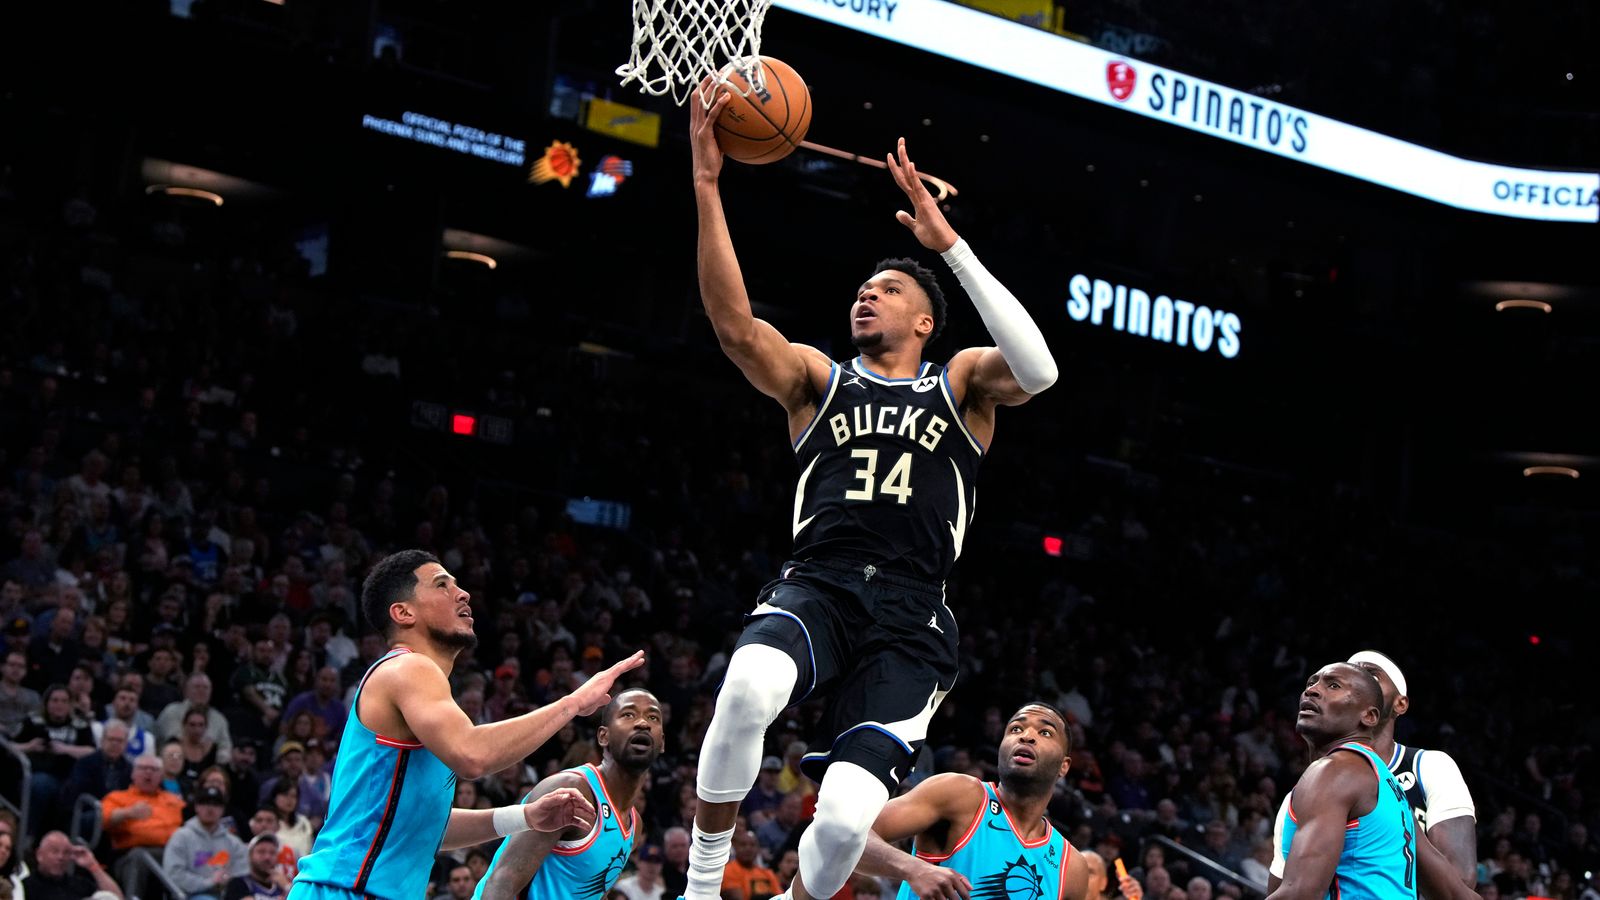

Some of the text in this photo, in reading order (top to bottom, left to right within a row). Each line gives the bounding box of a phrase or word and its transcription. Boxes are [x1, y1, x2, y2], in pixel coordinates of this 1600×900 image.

[1149, 73, 1308, 153] SPINATO'S
[1066, 273, 1242, 359] SPINATO'S
[829, 404, 949, 452] BUCKS
[845, 448, 913, 505] 34
[602, 804, 610, 818] 6
[990, 801, 999, 814] 6
